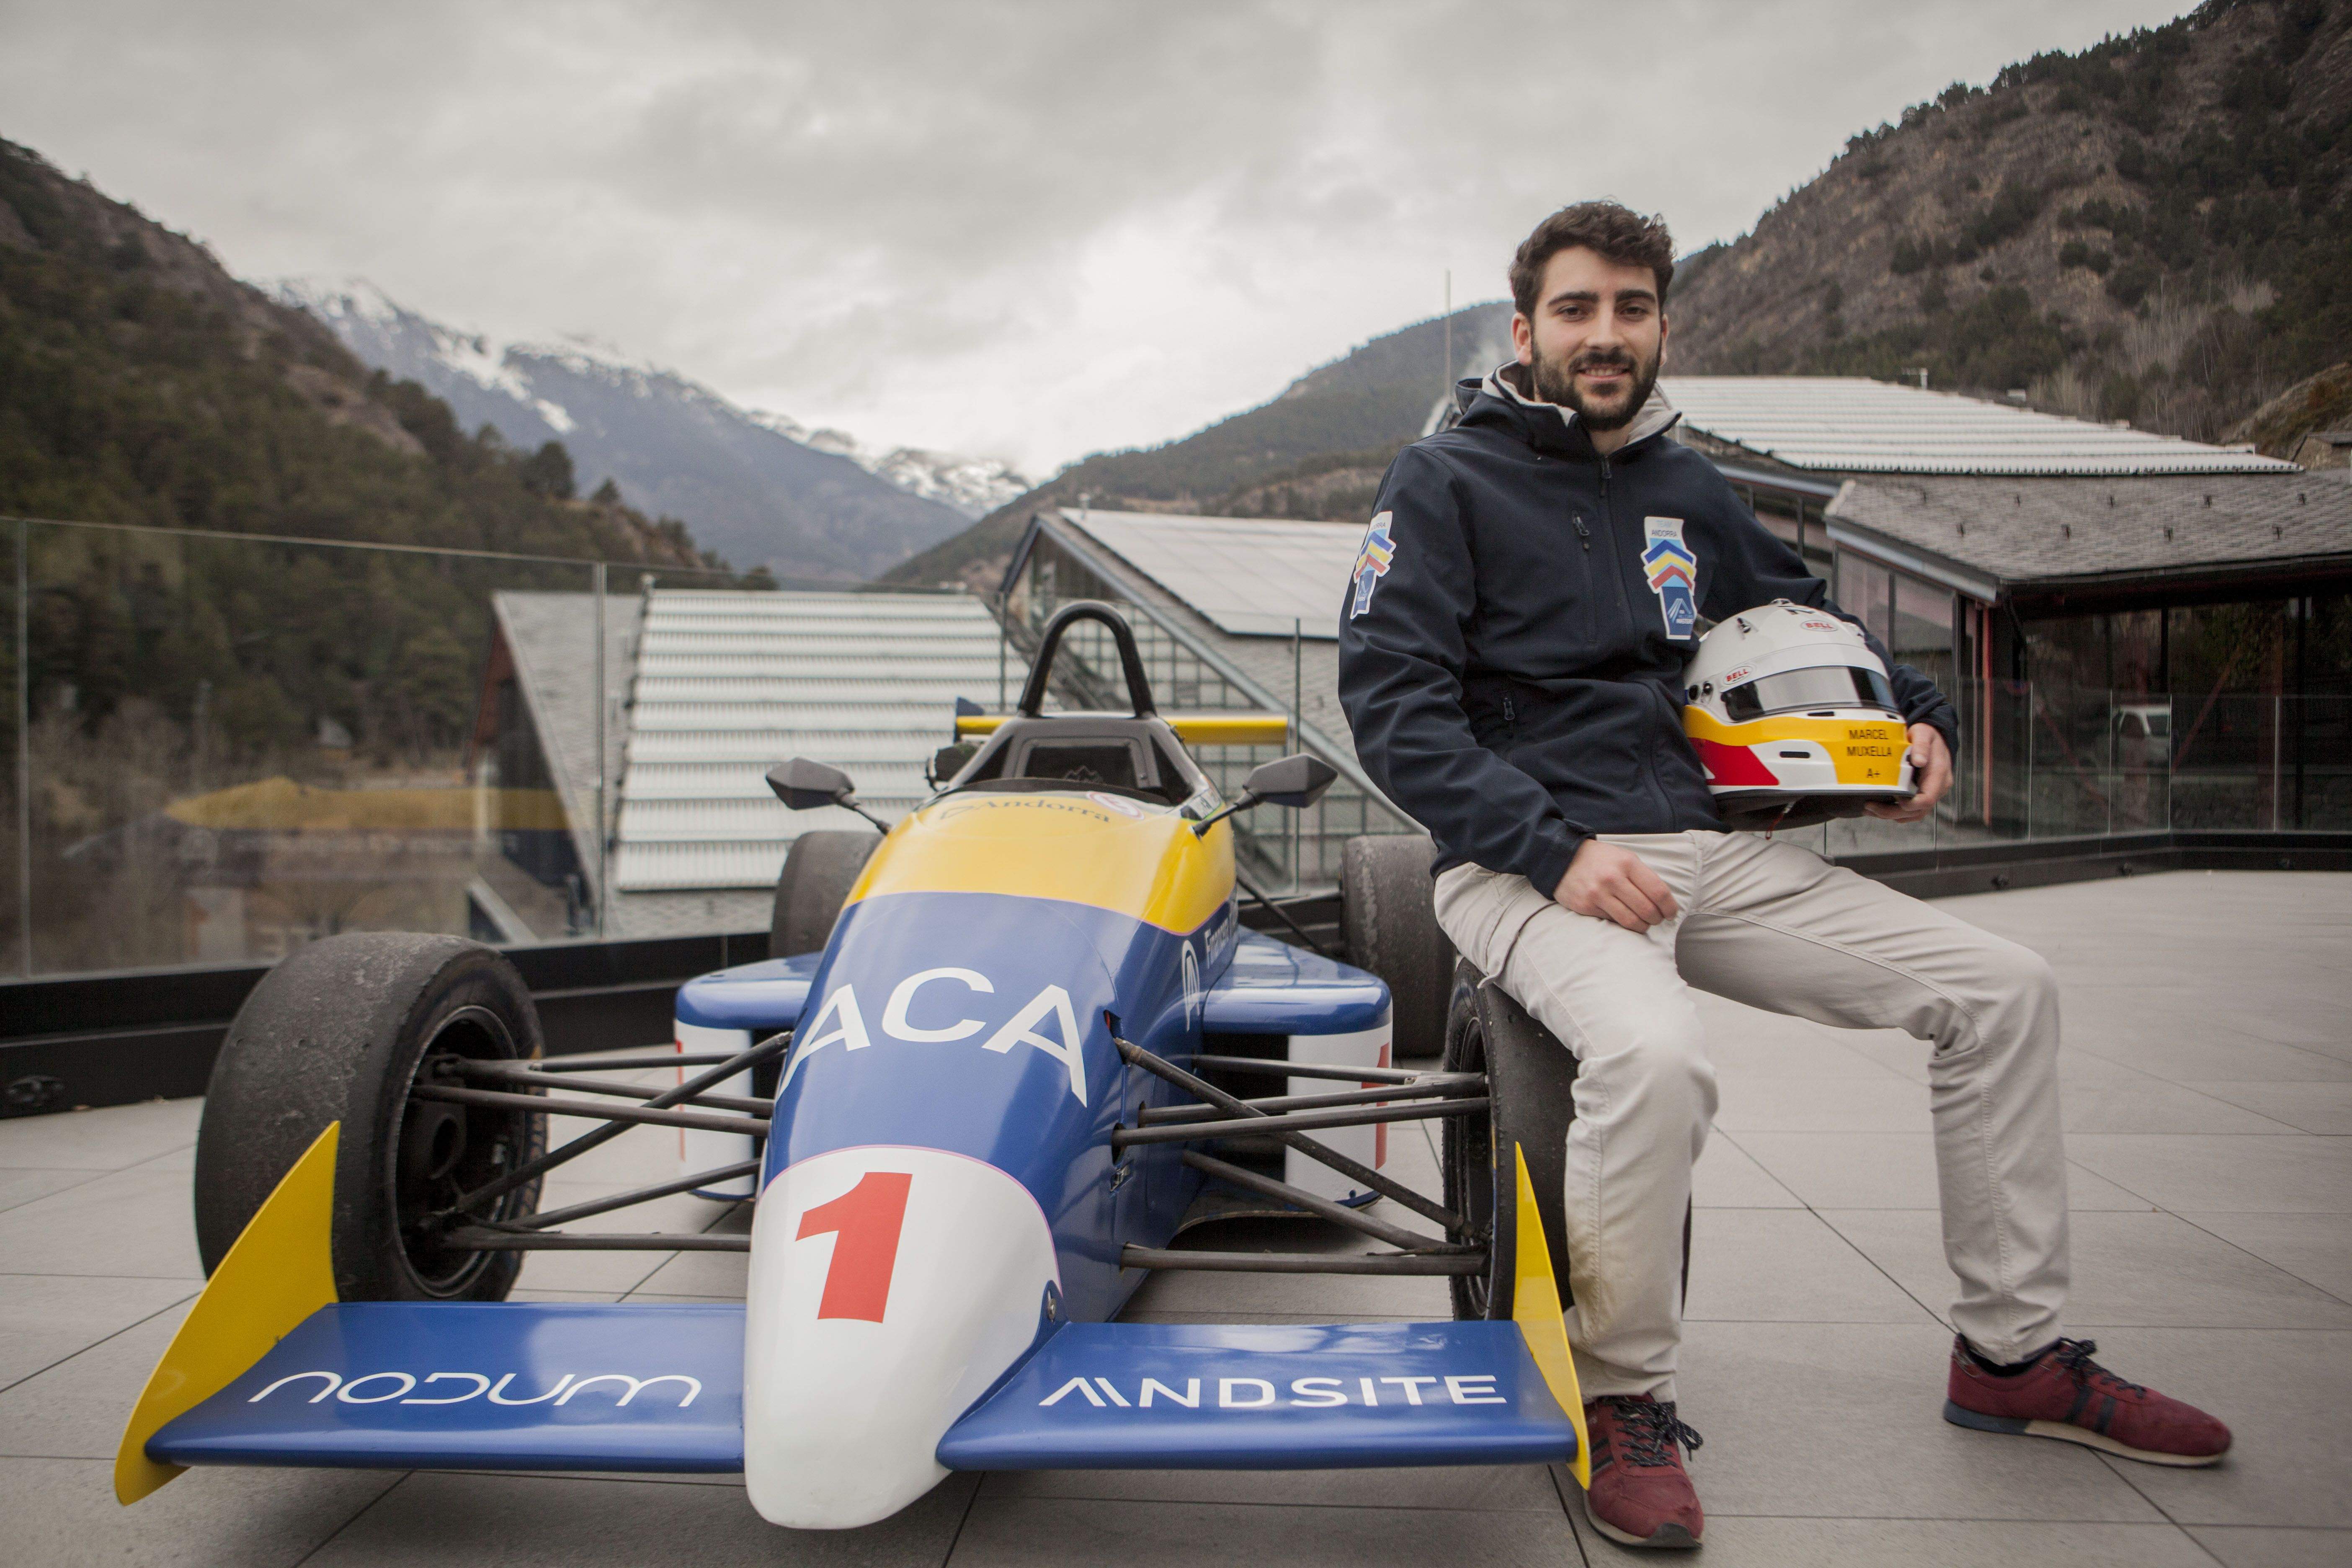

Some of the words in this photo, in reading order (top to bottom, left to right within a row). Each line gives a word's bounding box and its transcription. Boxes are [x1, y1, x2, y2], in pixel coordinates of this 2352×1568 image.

[1726, 669, 1749, 682] BELL
[1849, 729, 1889, 740] MARCEL
[1847, 746, 1893, 757] MUXELLA
[1866, 768, 1881, 779] A+
[974, 799, 1109, 823] Andorra
[775, 967, 1088, 1109] ACA
[794, 1171, 913, 1324] 1
[1039, 1375, 1508, 1408] ANDSITE
